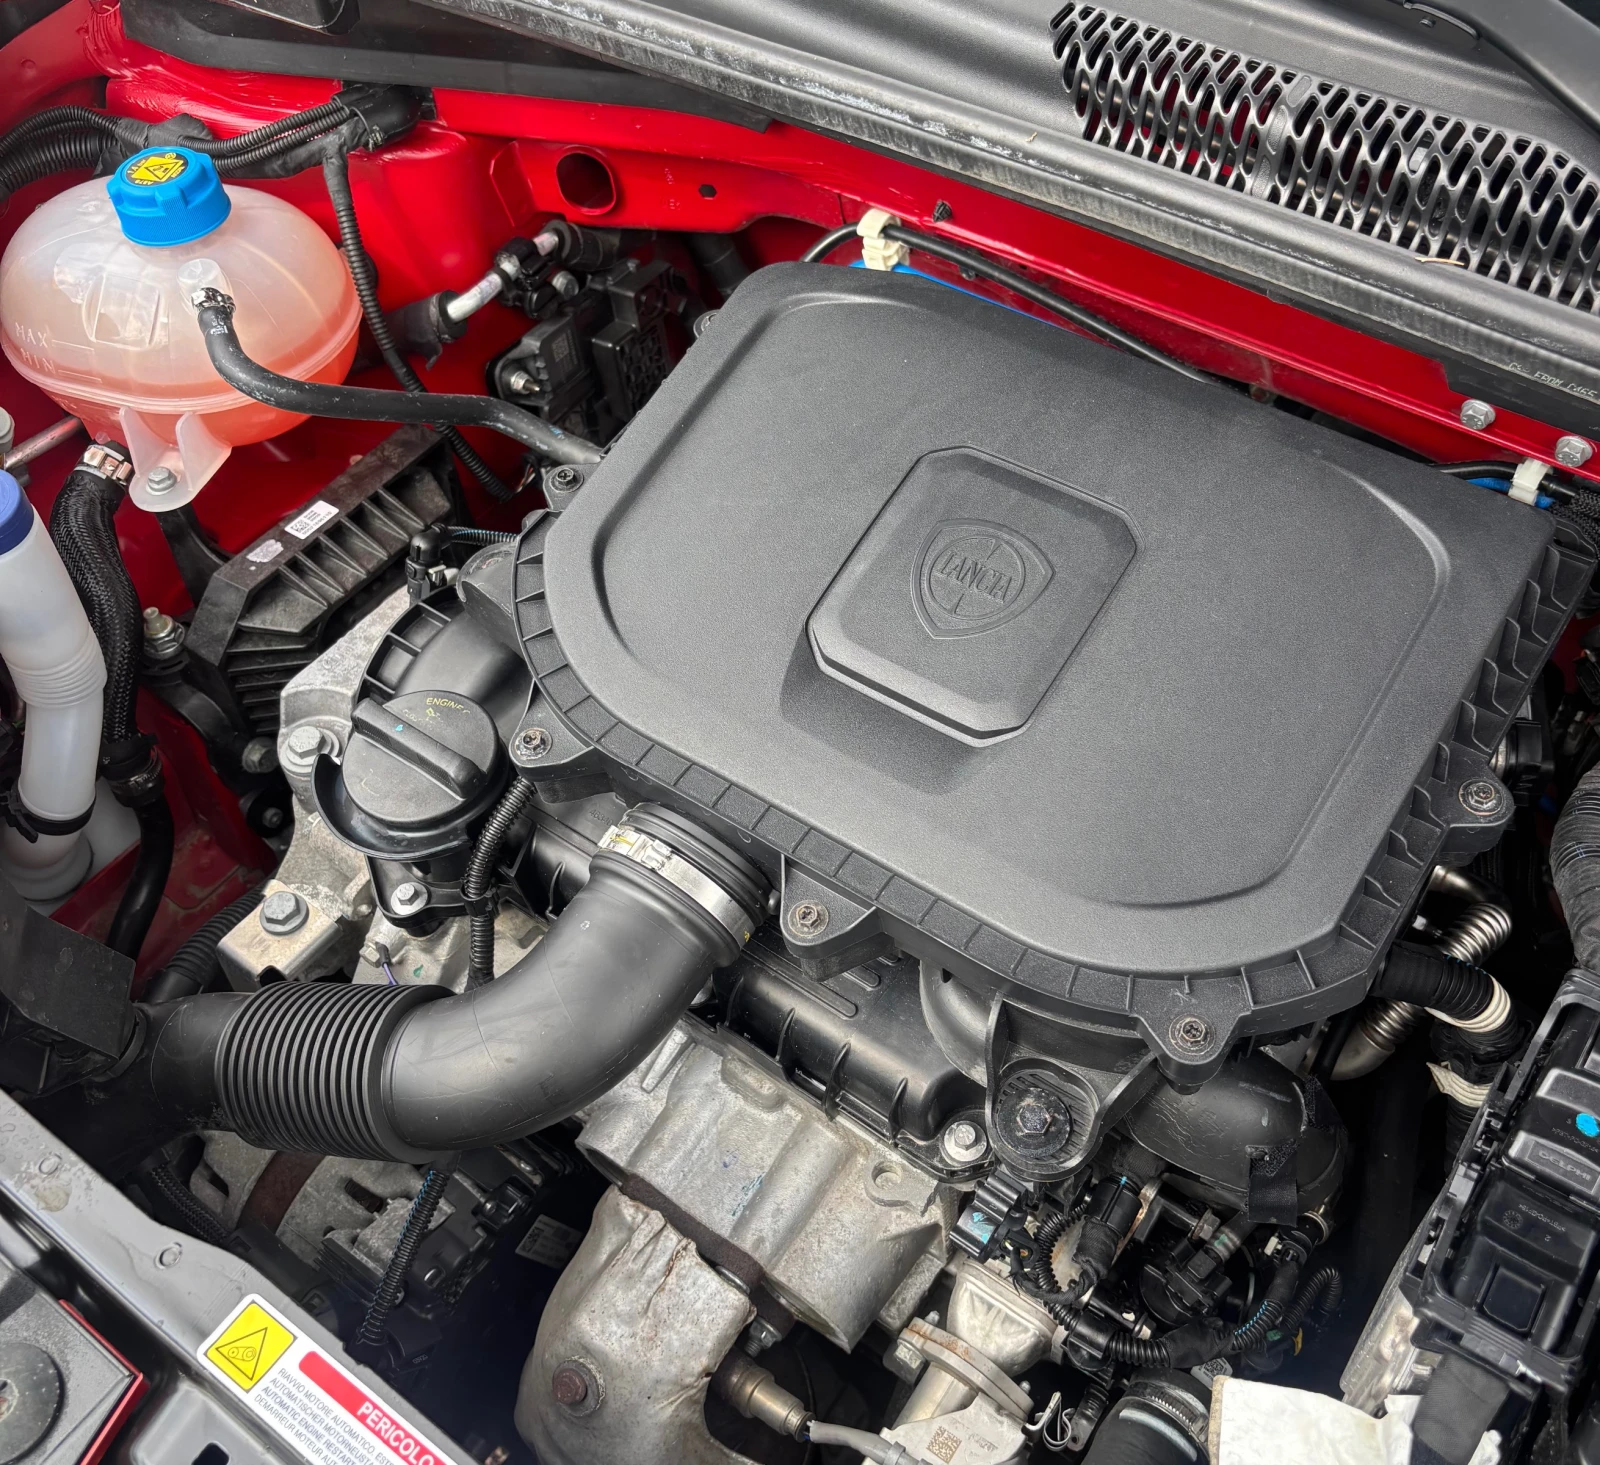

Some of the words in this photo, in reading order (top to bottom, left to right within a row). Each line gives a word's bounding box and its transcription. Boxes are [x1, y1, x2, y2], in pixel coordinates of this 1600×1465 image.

[15, 321, 48, 348] MAX
[20, 348, 56, 374] MIN
[933, 551, 1013, 605] LANCIA
[1538, 1149, 1592, 1181] DELPHI
[254, 1393, 296, 1432] DEMARREUR
[293, 1428, 324, 1458] MOTEUR
[262, 1386, 301, 1420] AUTOMATIC
[298, 1417, 326, 1442] ENGINE
[270, 1377, 325, 1428] AUTOMATISCHER
[278, 1367, 306, 1393] RIAVVIO
[303, 1389, 334, 1418] MOTORE
[330, 1414, 376, 1456] AUTOMATICO.
[356, 1401, 435, 1465] PERICOLO
